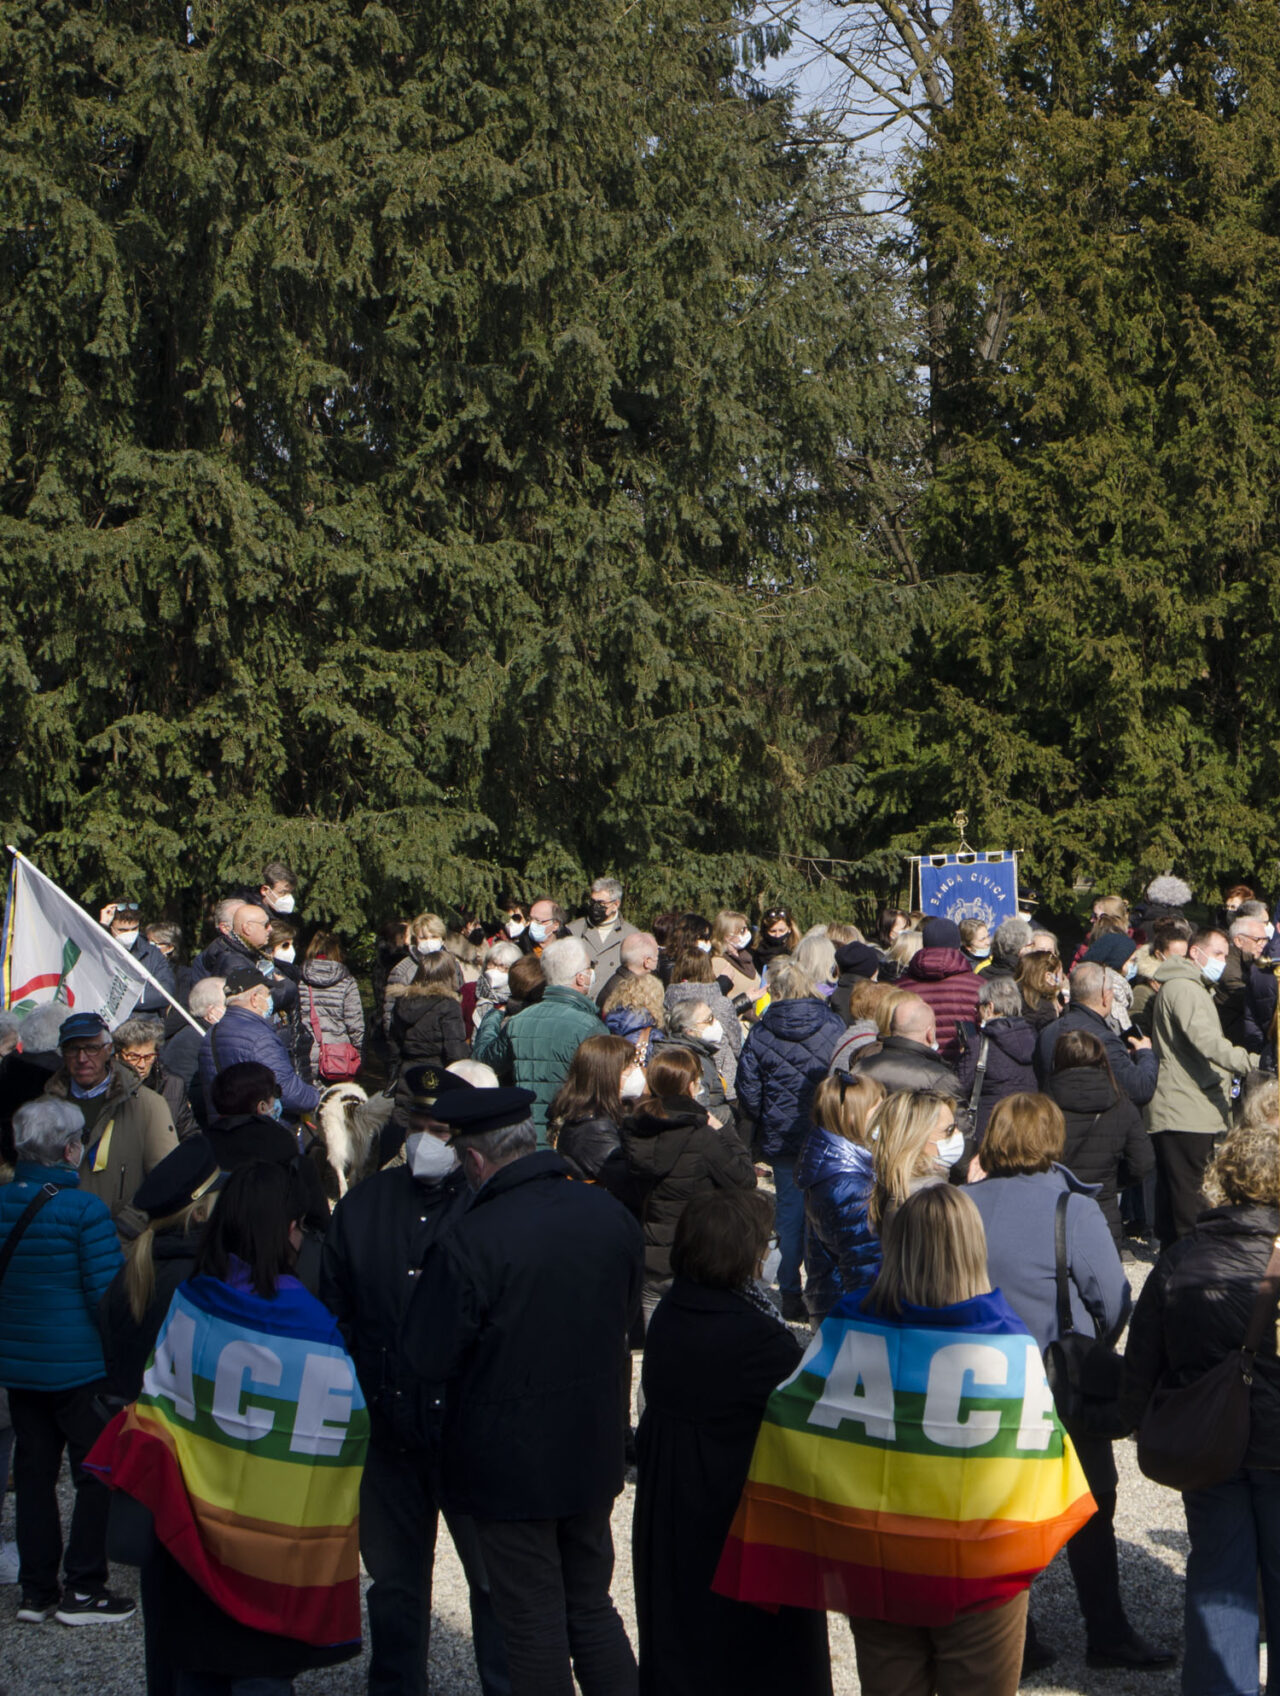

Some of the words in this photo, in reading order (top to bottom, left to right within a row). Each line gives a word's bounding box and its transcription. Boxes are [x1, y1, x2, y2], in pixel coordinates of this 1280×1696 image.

[930, 874, 963, 906] BANDA
[970, 872, 1007, 902] CIVICA
[141, 1307, 354, 1457] ACE
